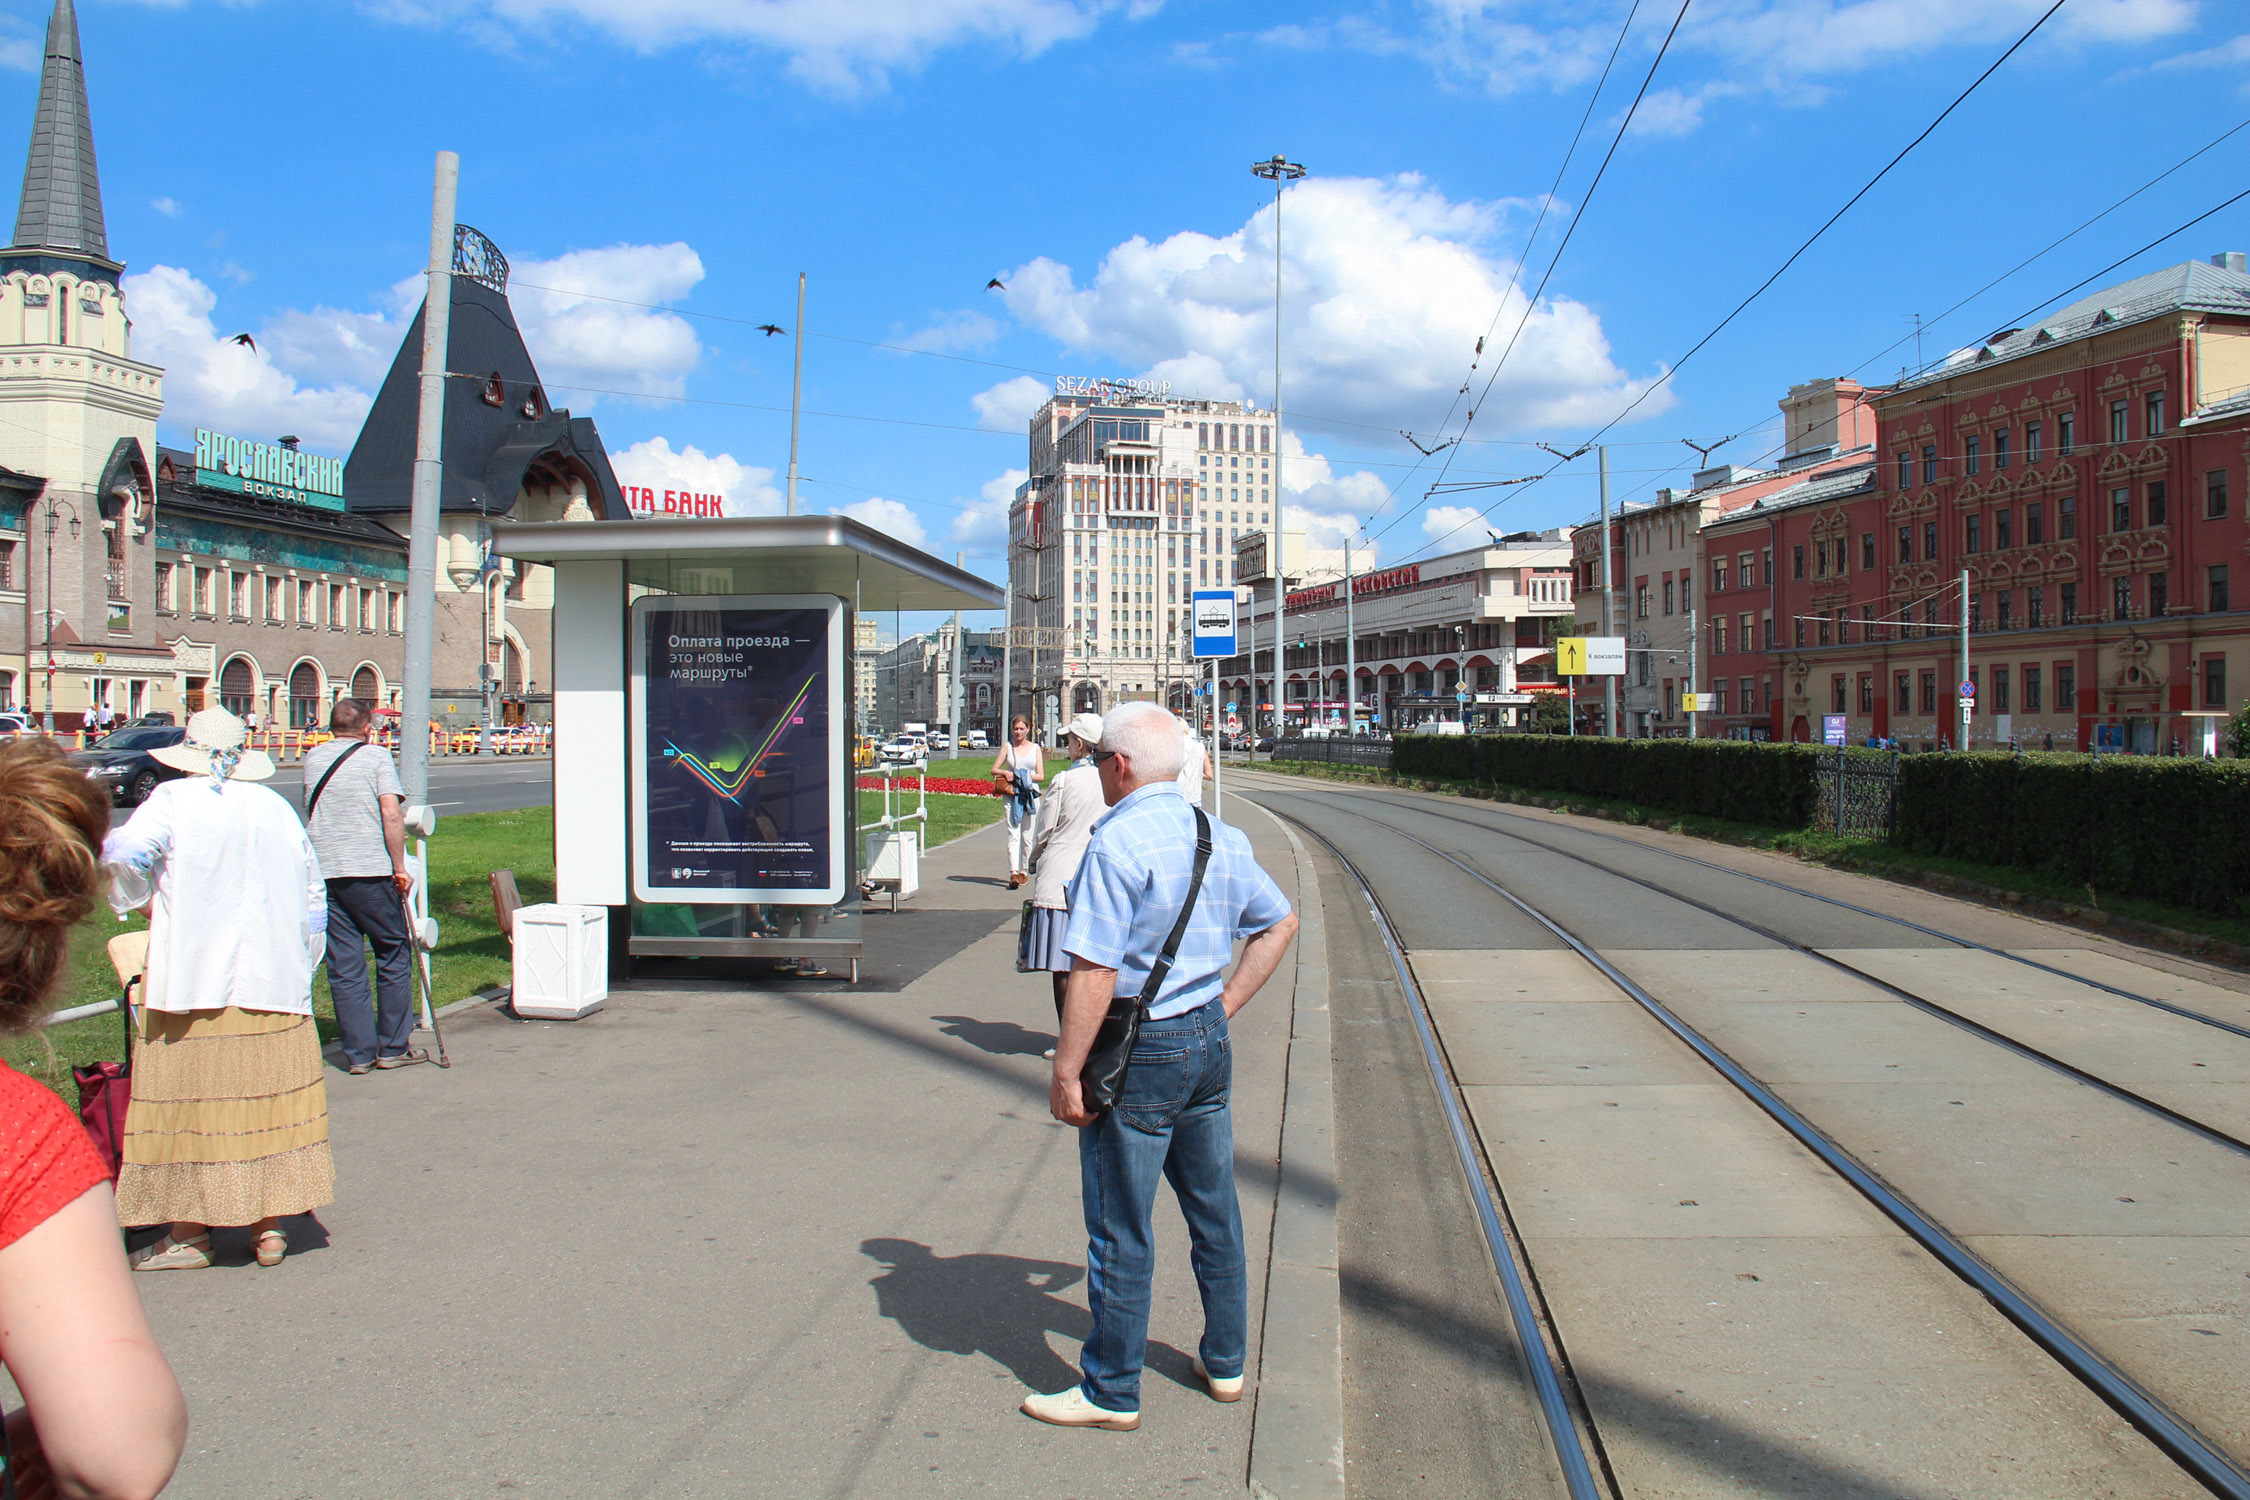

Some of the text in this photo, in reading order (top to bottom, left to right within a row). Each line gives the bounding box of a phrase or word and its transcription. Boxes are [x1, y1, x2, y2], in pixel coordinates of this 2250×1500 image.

[1056, 375, 1172, 395] SEZAR GROUP
[194, 427, 344, 497] ЯРОСЛАВСКИЙ
[243, 480, 307, 503] ВОКЗАЛ
[664, 489, 724, 518] БАНК
[1351, 563, 1420, 596] ОСКОВСКИЙ
[668, 634, 723, 649] Оплата
[726, 635, 790, 650] проезда
[96, 653, 103, 663] 2
[669, 652, 744, 664] это новые
